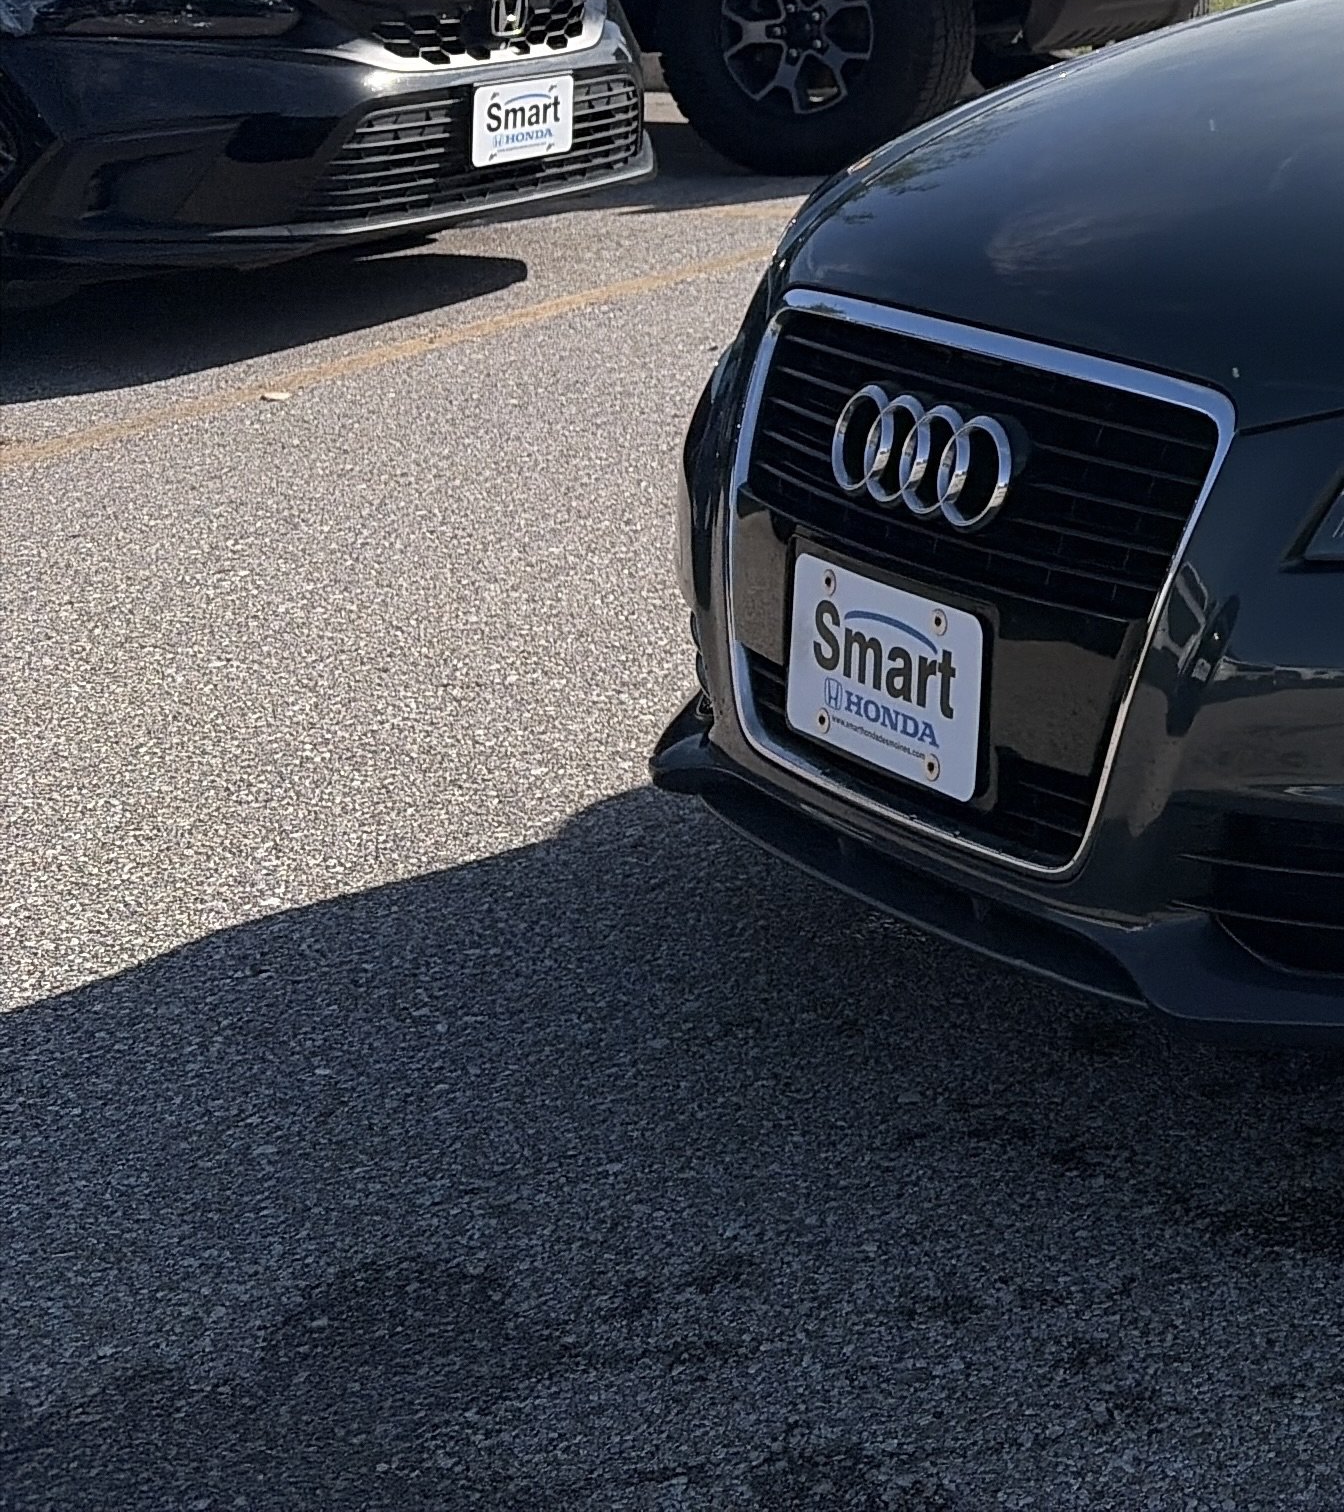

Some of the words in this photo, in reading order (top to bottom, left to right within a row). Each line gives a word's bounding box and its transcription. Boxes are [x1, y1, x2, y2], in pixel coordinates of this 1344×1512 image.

[486, 95, 560, 133] Smart
[505, 128, 552, 145] HONDA
[813, 599, 956, 720] Smart
[845, 690, 940, 749] HONDA
